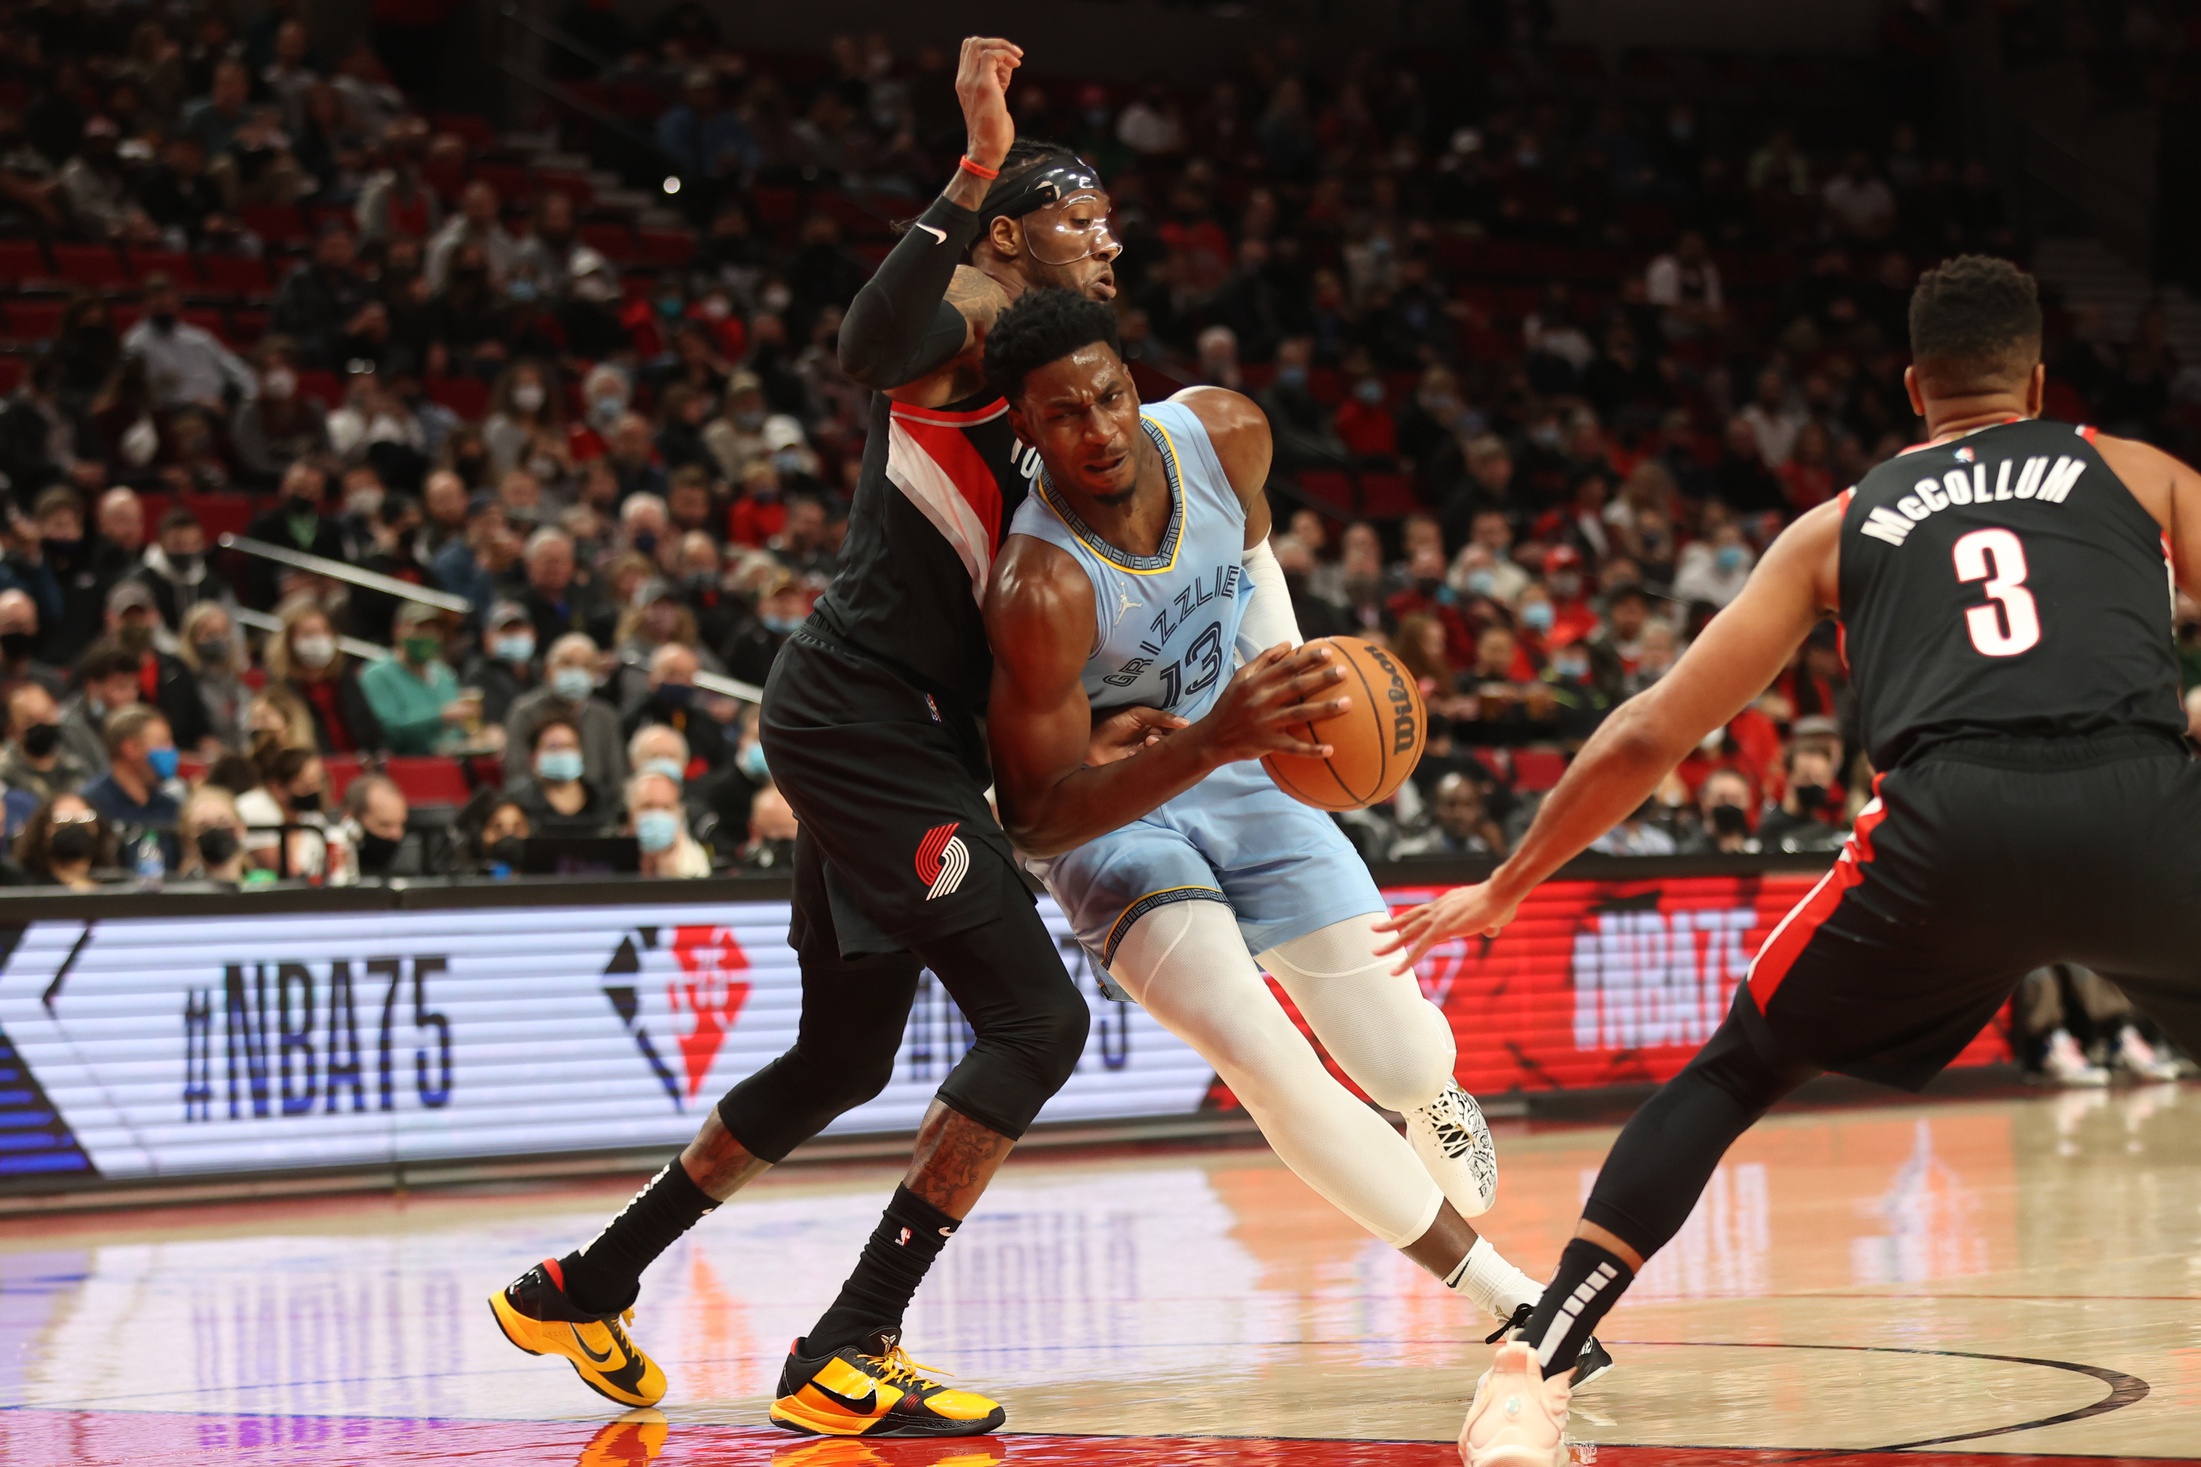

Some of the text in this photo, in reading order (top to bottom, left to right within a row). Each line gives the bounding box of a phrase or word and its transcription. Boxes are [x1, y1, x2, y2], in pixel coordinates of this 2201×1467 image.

[1860, 455, 2087, 547] McCOLLUM
[1103, 565, 1239, 687] GRIZZLIE
[1951, 527, 2043, 659] 3
[1160, 621, 1222, 708] 13
[184, 954, 453, 1122] #NBA75
